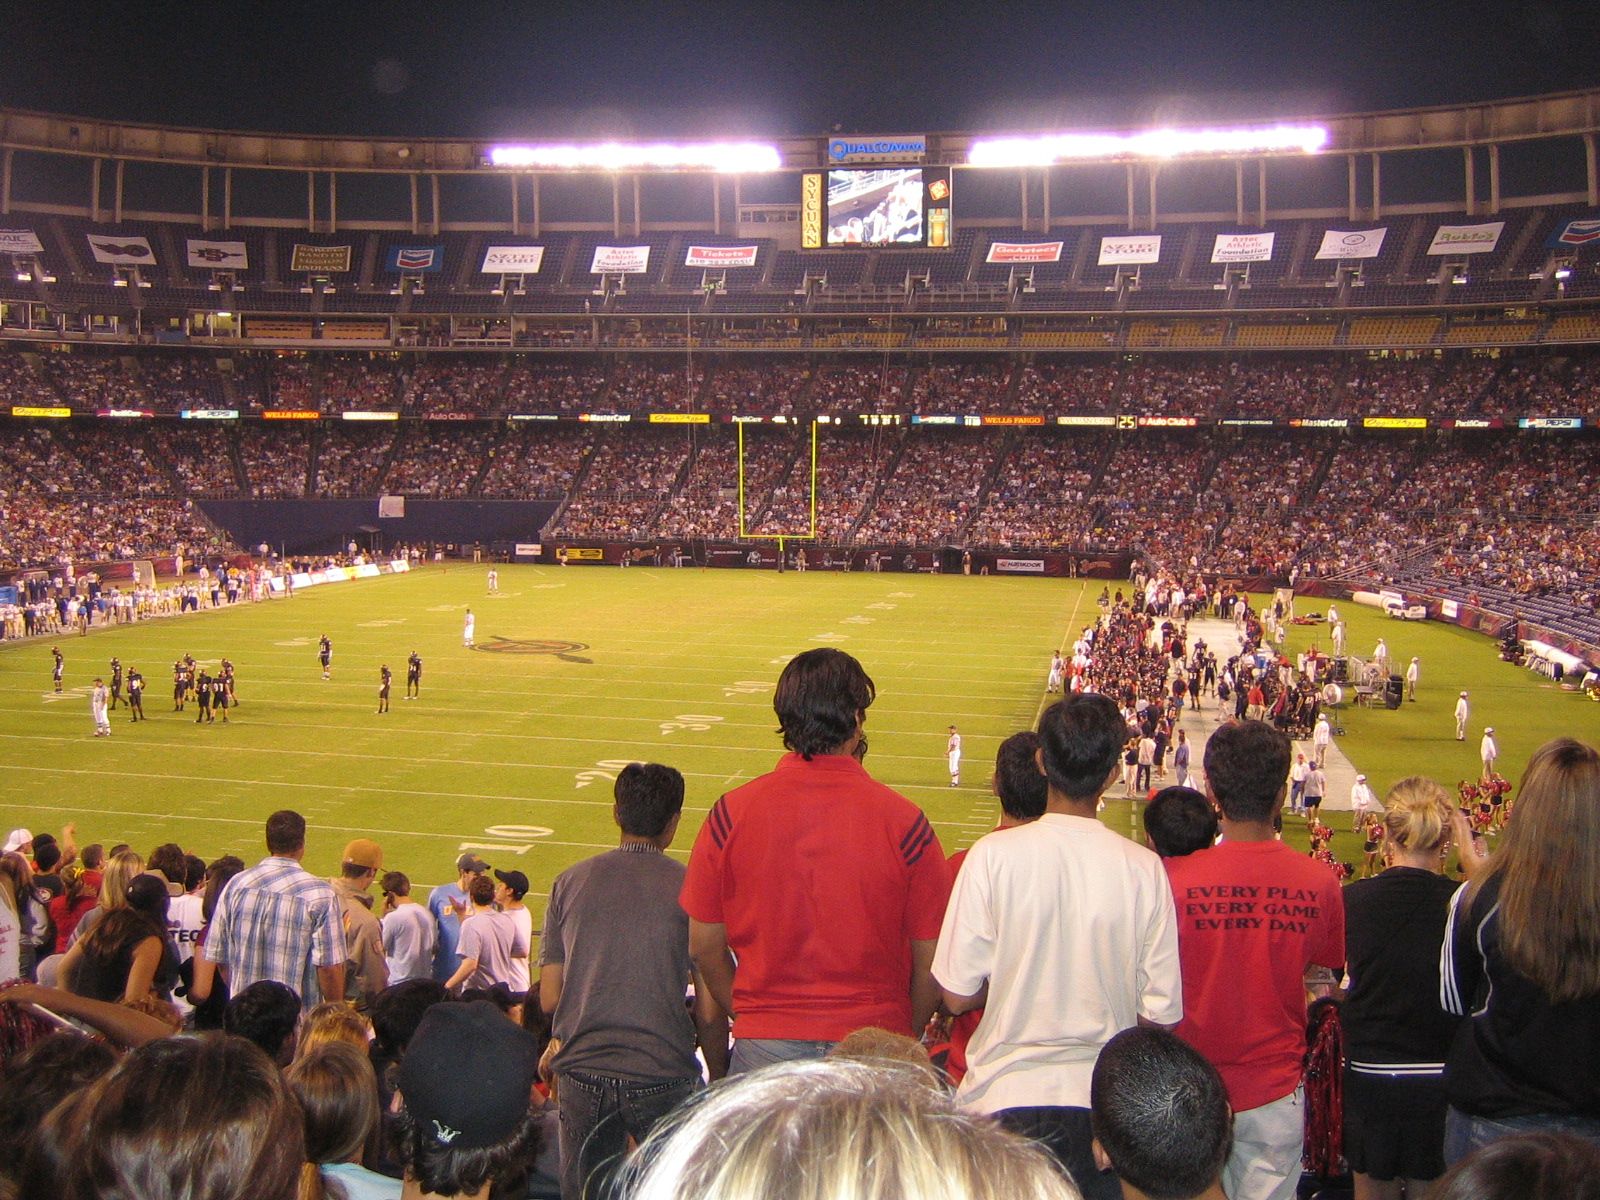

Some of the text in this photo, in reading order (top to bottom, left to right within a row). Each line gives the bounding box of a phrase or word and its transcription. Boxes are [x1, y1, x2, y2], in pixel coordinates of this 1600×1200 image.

[829, 140, 923, 160] QUALCOMM
[806, 177, 817, 245] SYCUAN
[1119, 416, 1135, 429] 25
[1302, 419, 1348, 427] MasterCard
[459, 824, 555, 855] 10
[1186, 886, 1319, 902] EVERY PLAY
[1186, 902, 1321, 918] EVERY GAME
[1195, 917, 1310, 933] EVERY DAY
